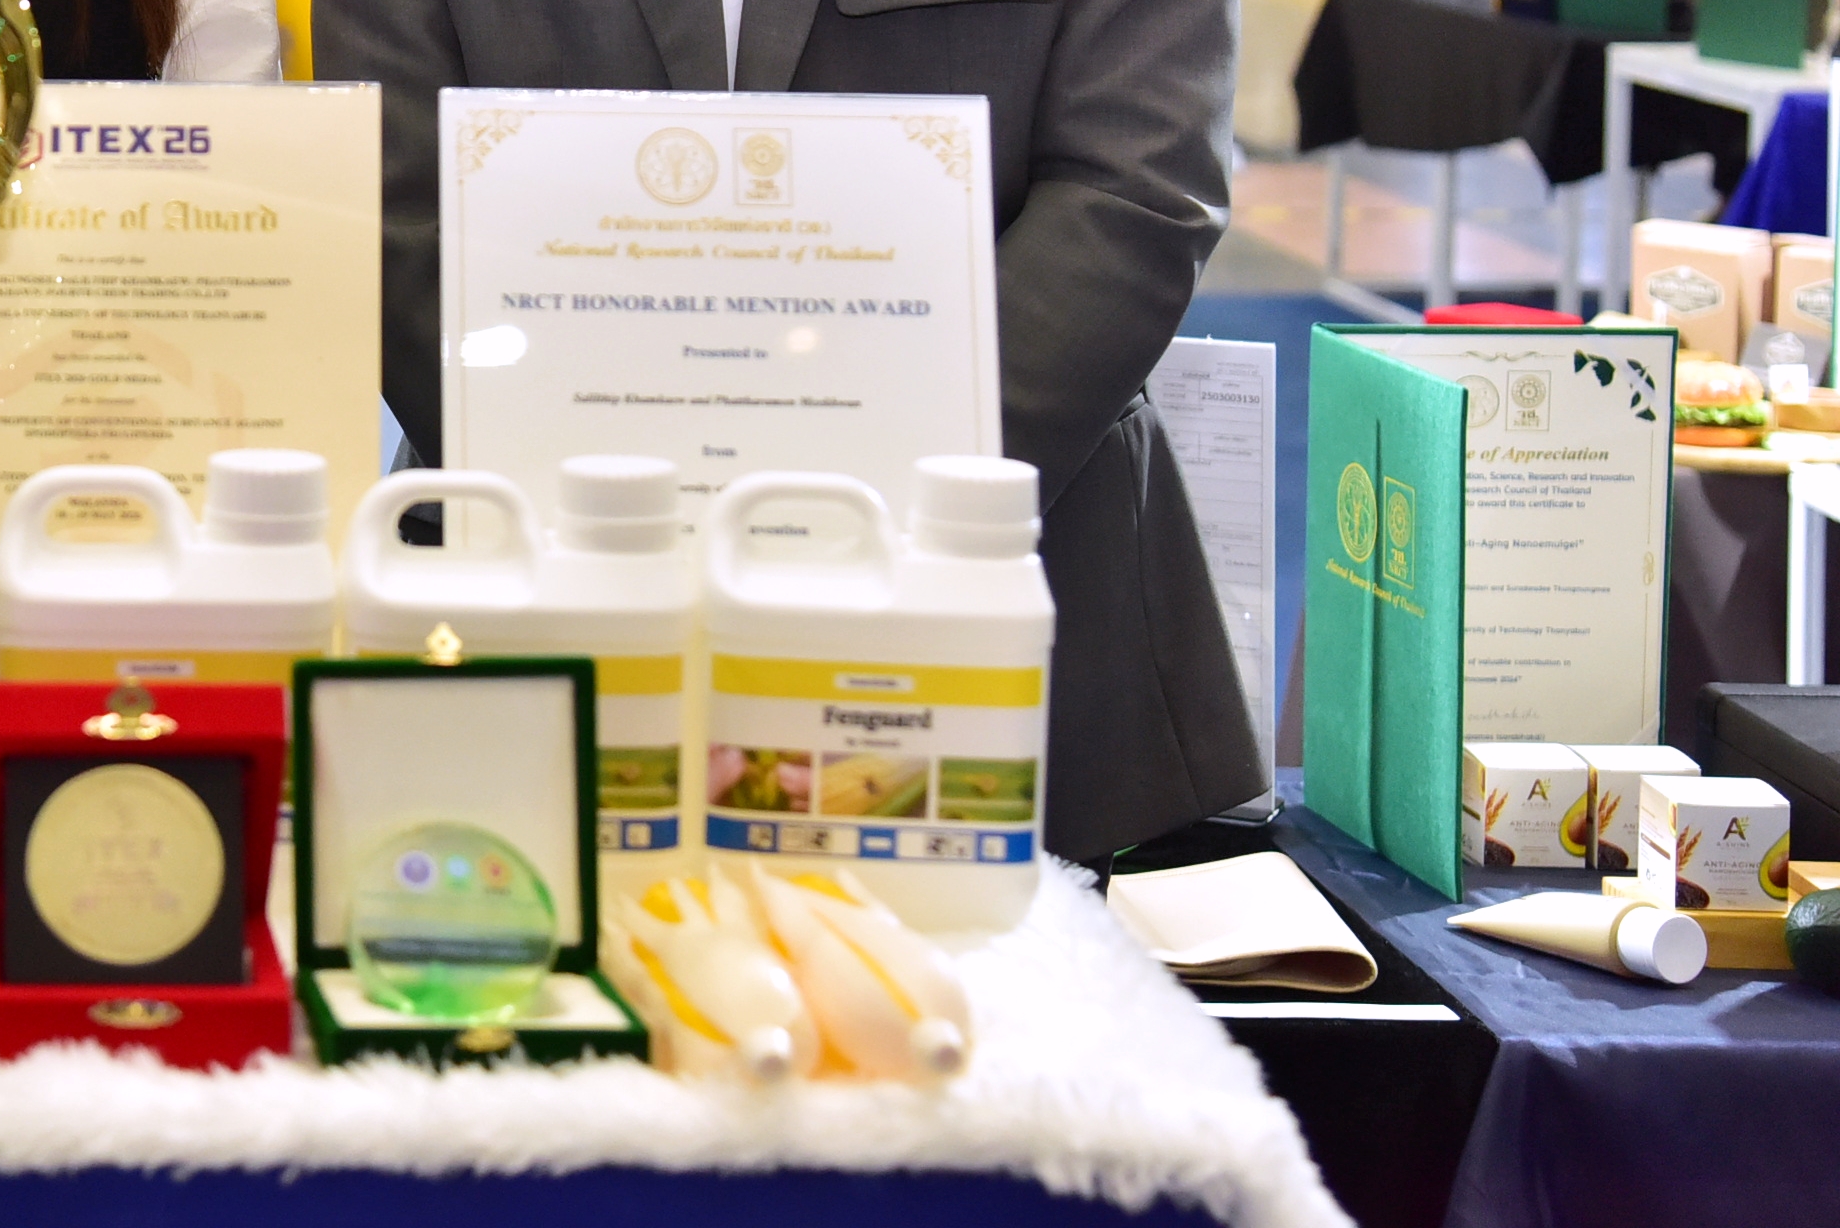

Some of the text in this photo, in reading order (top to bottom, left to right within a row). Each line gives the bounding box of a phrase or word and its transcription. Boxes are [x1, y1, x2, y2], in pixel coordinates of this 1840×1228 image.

[119, 201, 150, 232] of
[163, 199, 278, 233] Award
[536, 238, 895, 264] National Research Council of Thailand
[502, 292, 931, 316] NRCT HONORABLE MENTION AWARD
[683, 345, 751, 359] Presented
[1480, 446, 1610, 463] of Appreciation
[1490, 472, 1525, 482] Science,
[1528, 472, 1568, 481] Research
[1570, 472, 1588, 481] and
[1589, 473, 1635, 482] Innovation
[1466, 485, 1592, 495] esearch Council of Thailand
[1477, 499, 1507, 508] award
[1509, 499, 1526, 508] this
[1528, 499, 1573, 508] certificate
[1576, 500, 1586, 508] to
[1465, 538, 1509, 550] ti-Aging
[822, 704, 933, 731] Fenguard
